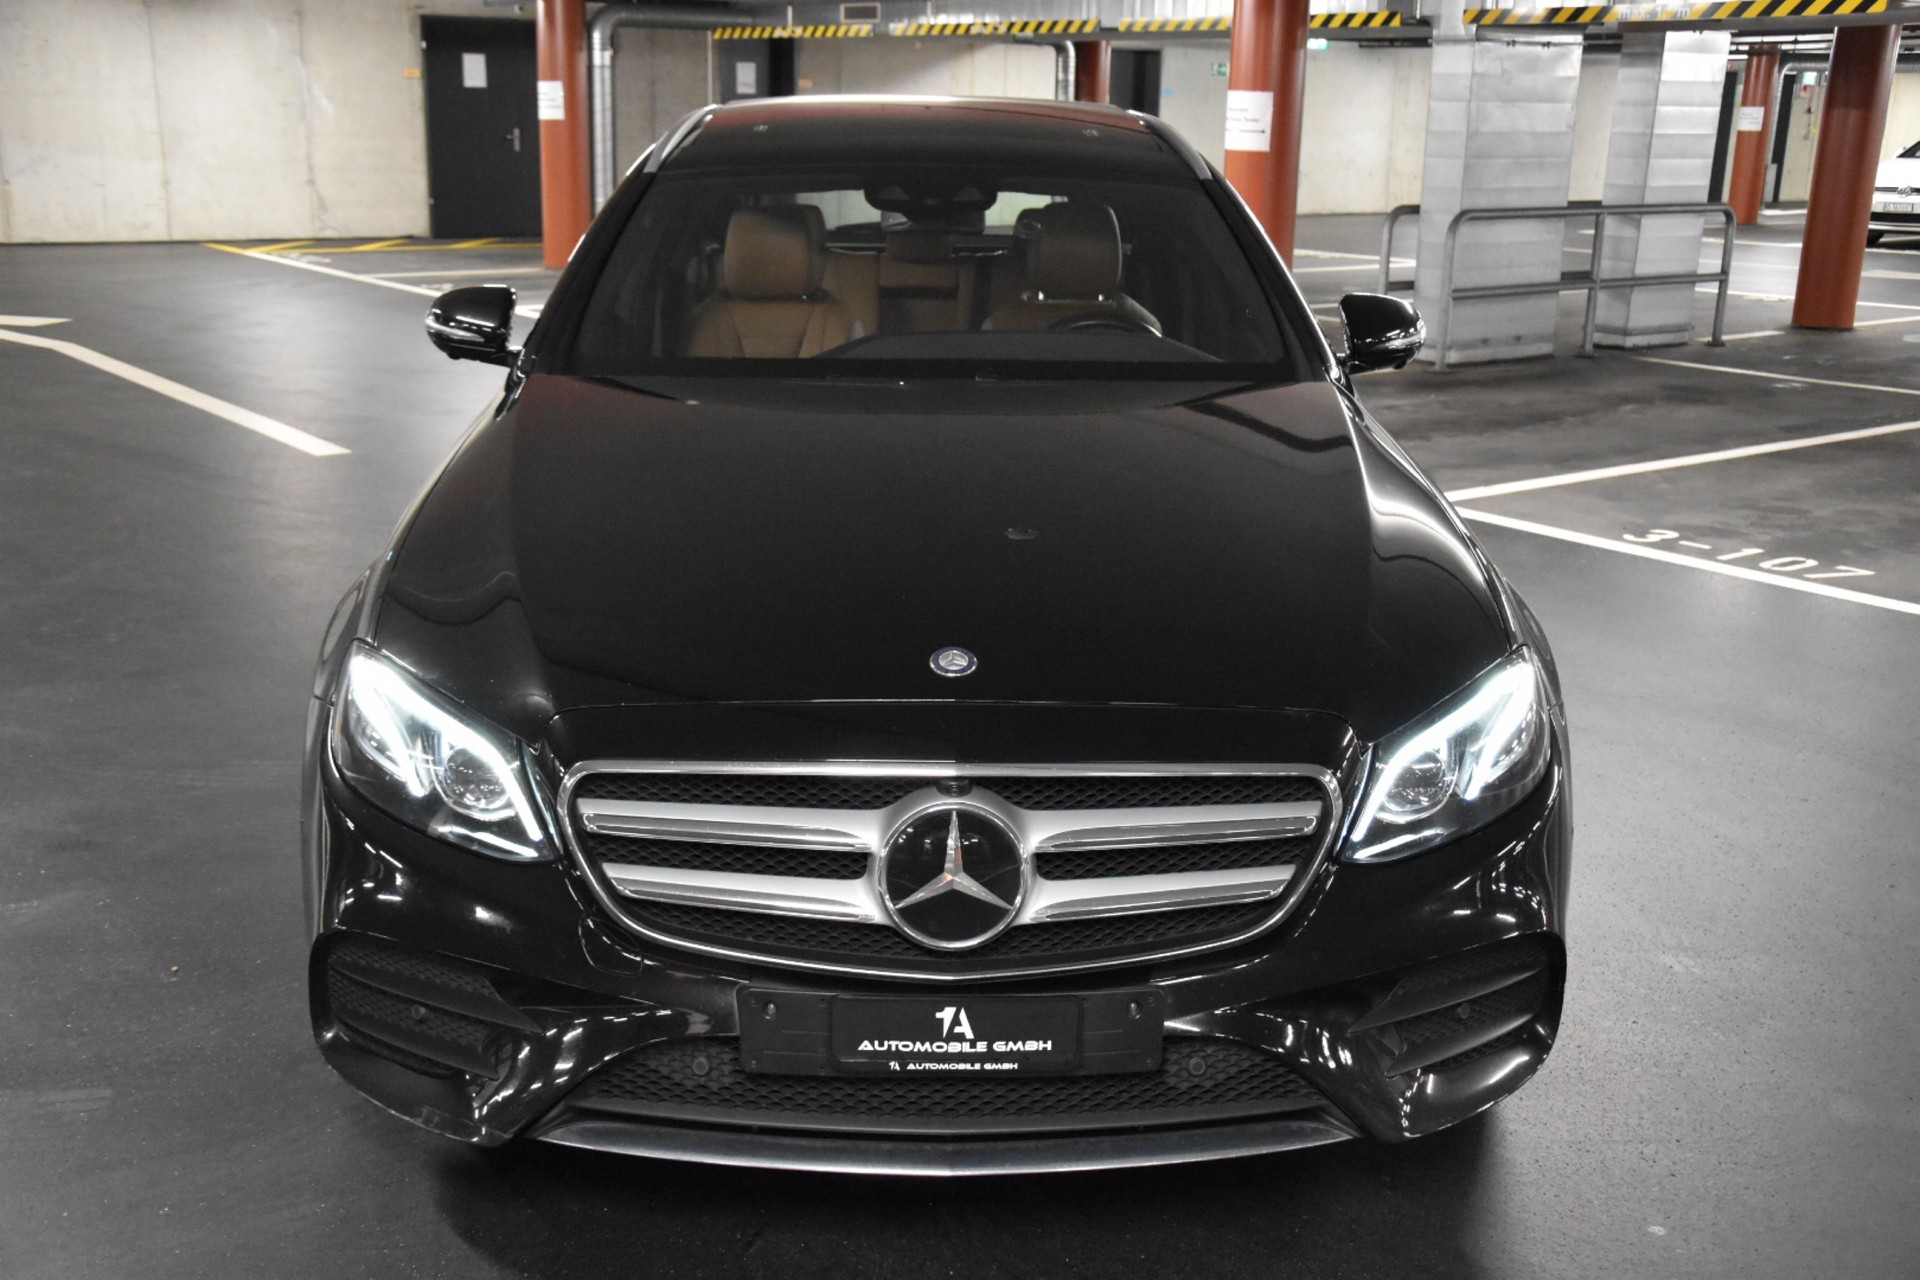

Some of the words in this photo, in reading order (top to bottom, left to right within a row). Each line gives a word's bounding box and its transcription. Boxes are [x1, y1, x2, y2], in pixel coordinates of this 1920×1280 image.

[1623, 529, 1875, 579] 3-107
[858, 1040, 988, 1053] AUTOMOBILE
[993, 1040, 1052, 1052] GMBH
[907, 1062, 981, 1070] AUTOMOBILE
[983, 1062, 1018, 1070] GMBH
